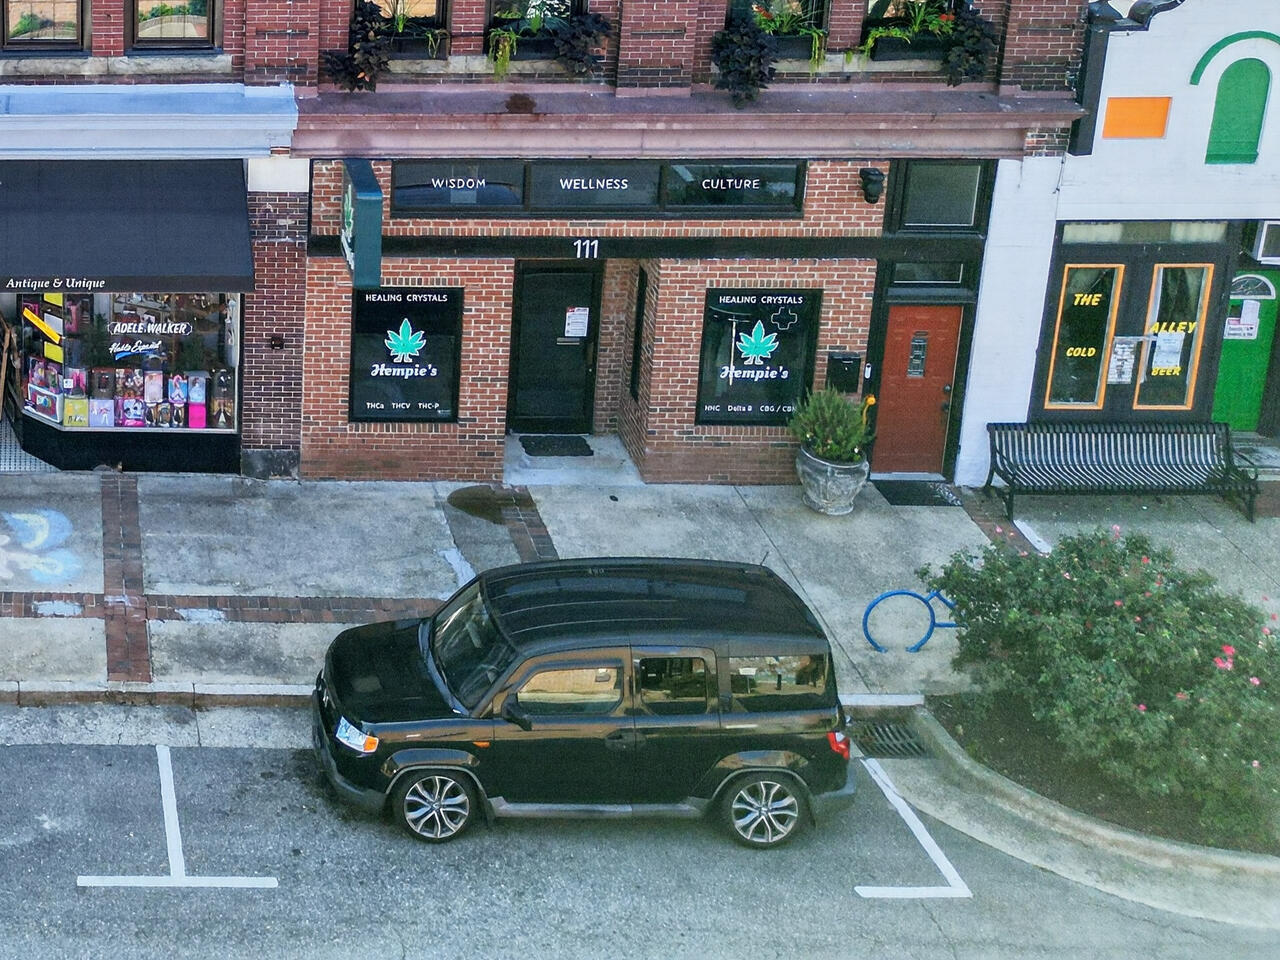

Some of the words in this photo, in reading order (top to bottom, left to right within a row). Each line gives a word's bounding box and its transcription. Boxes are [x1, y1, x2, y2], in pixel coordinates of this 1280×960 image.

[432, 178, 486, 189] WISDOM
[560, 178, 628, 190] WELLNESS
[702, 178, 760, 190] CULTURE
[573, 239, 600, 259] 111
[6, 278, 50, 291] Antique
[53, 278, 63, 288] &
[65, 278, 106, 290] Unique
[365, 294, 402, 302] HEALING
[406, 294, 448, 302] CRYSTALS
[719, 295, 757, 304] HEALING
[761, 295, 803, 304] CRYSTALS
[1073, 293, 1102, 306] THE
[146, 322, 187, 334] WALKER
[1150, 321, 1197, 334] ALLEY
[1066, 347, 1096, 357] COLD
[370, 363, 438, 379] Hempie's
[719, 366, 789, 382] Hempie's
